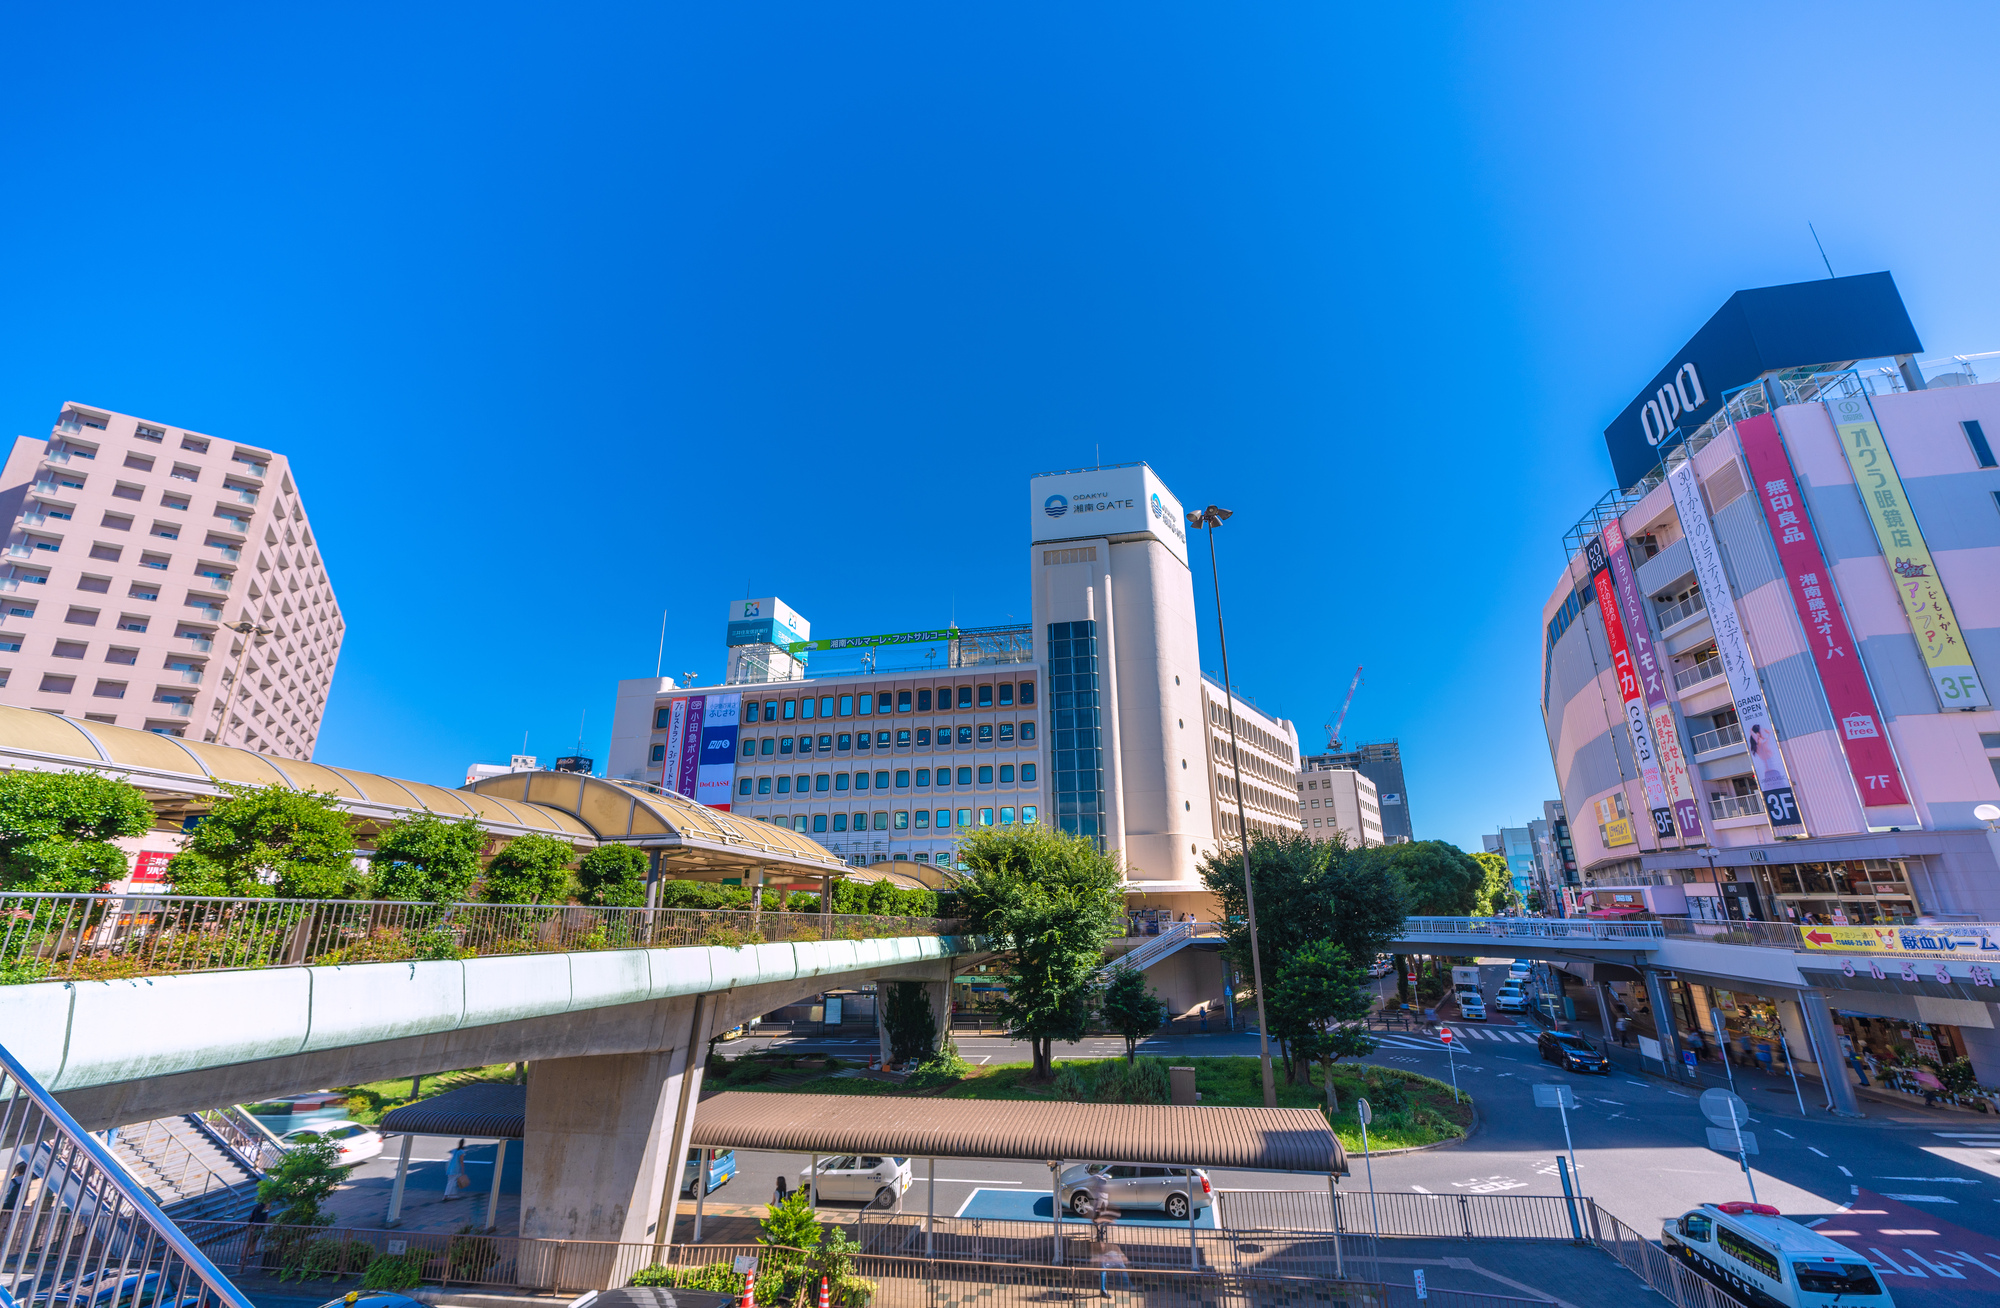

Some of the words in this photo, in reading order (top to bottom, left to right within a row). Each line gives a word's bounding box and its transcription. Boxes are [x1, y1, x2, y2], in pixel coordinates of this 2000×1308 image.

[1073, 492, 1108, 501] ODAKYU
[1851, 428, 1912, 548] オグラ眼鏡店
[1073, 503, 1094, 513] 湘南
[1096, 499, 1134, 511] GATE
[1765, 478, 1806, 544] 無印良品
[1605, 524, 1622, 551] 薬
[1617, 555, 1640, 627] ドラッグストア
[1635, 632, 1660, 695] トモズ
[1799, 572, 1845, 660] 湘南藤沢オーパ
[830, 630, 954, 649] 湘南ベルマーレ・フットサルコート
[1615, 649, 1635, 695] コカ
[1941, 676, 1976, 699] 3F
[1737, 694, 1762, 708] GRAND
[1742, 703, 1762, 715] OPEN
[709, 709, 736, 718] ふじさわ
[1630, 705, 1651, 763] coca
[1846, 720, 1871, 728] Tax-
[1849, 728, 1874, 736] free
[708, 739, 731, 750] HIS
[782, 738, 793, 747] 6F
[1661, 714, 1684, 775] 処方せん
[1655, 717, 1679, 797] お受け致します
[1864, 775, 1890, 790] 7F
[1767, 792, 1794, 821] 3F
[1655, 812, 1672, 833] 8F
[1679, 805, 1696, 830] 1F
[149, 857, 169, 866] 三井の
[1833, 931, 1874, 939] ファミリー通り
[1900, 935, 2000, 951] 献血ルーム
[1694, 1252, 1752, 1296] POLICE
